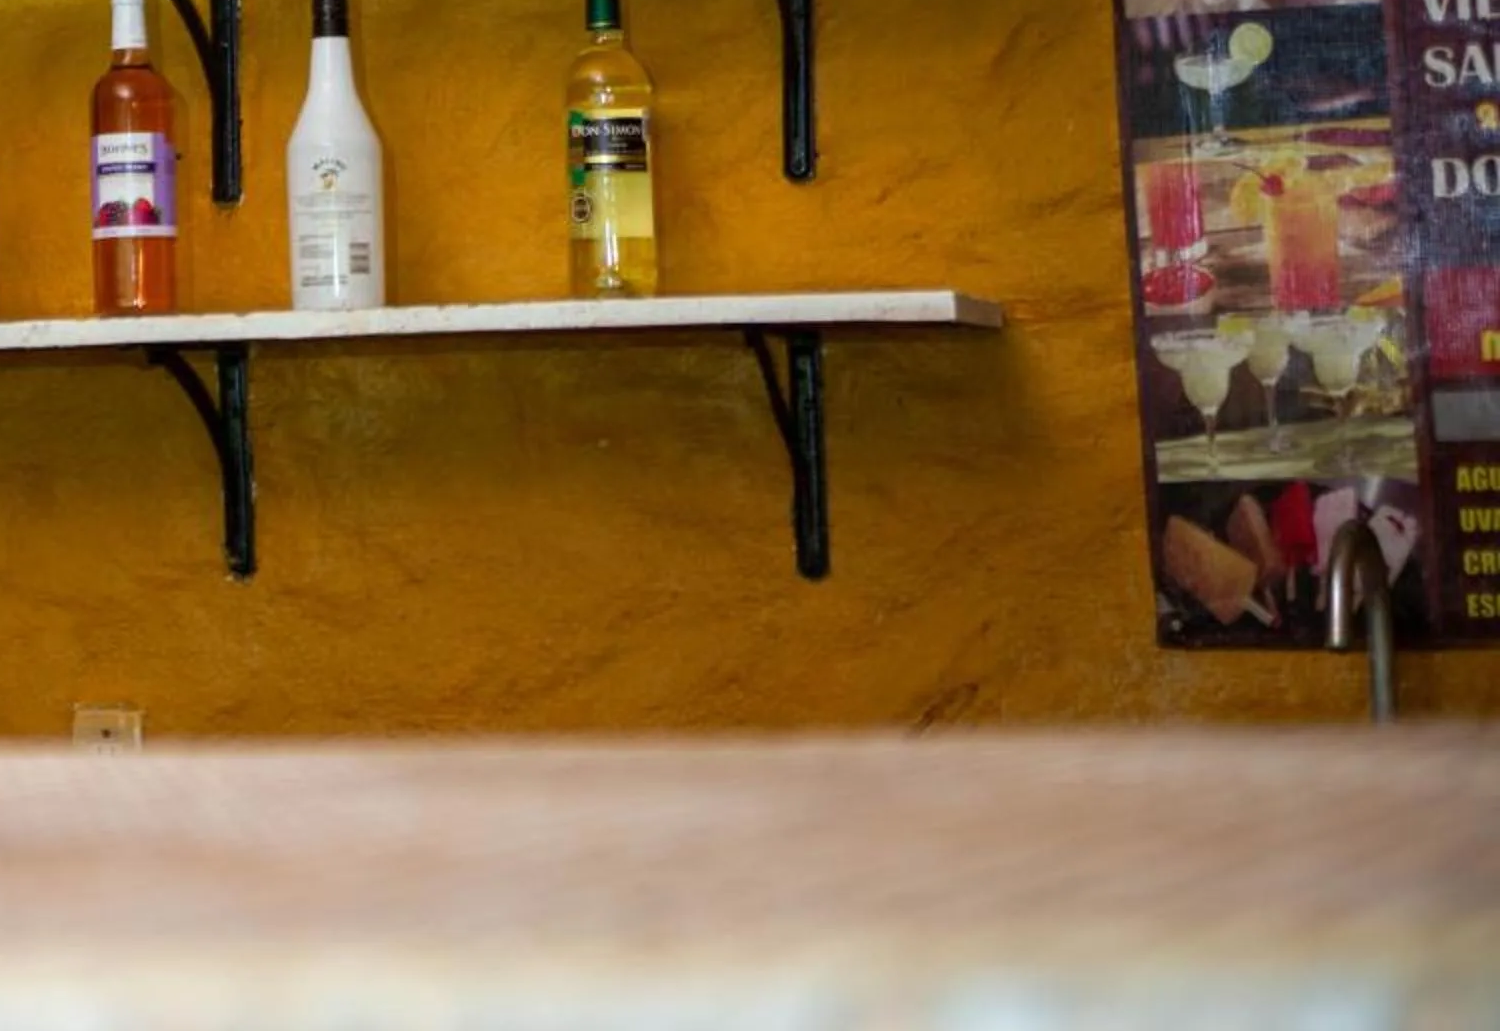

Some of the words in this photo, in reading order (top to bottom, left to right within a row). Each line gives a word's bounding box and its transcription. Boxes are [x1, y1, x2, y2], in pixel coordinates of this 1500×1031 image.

[1424, 42, 1500, 87] SA
[1432, 155, 1500, 198] DO
[1463, 549, 1500, 576] CR
[1466, 592, 1500, 618] ES
